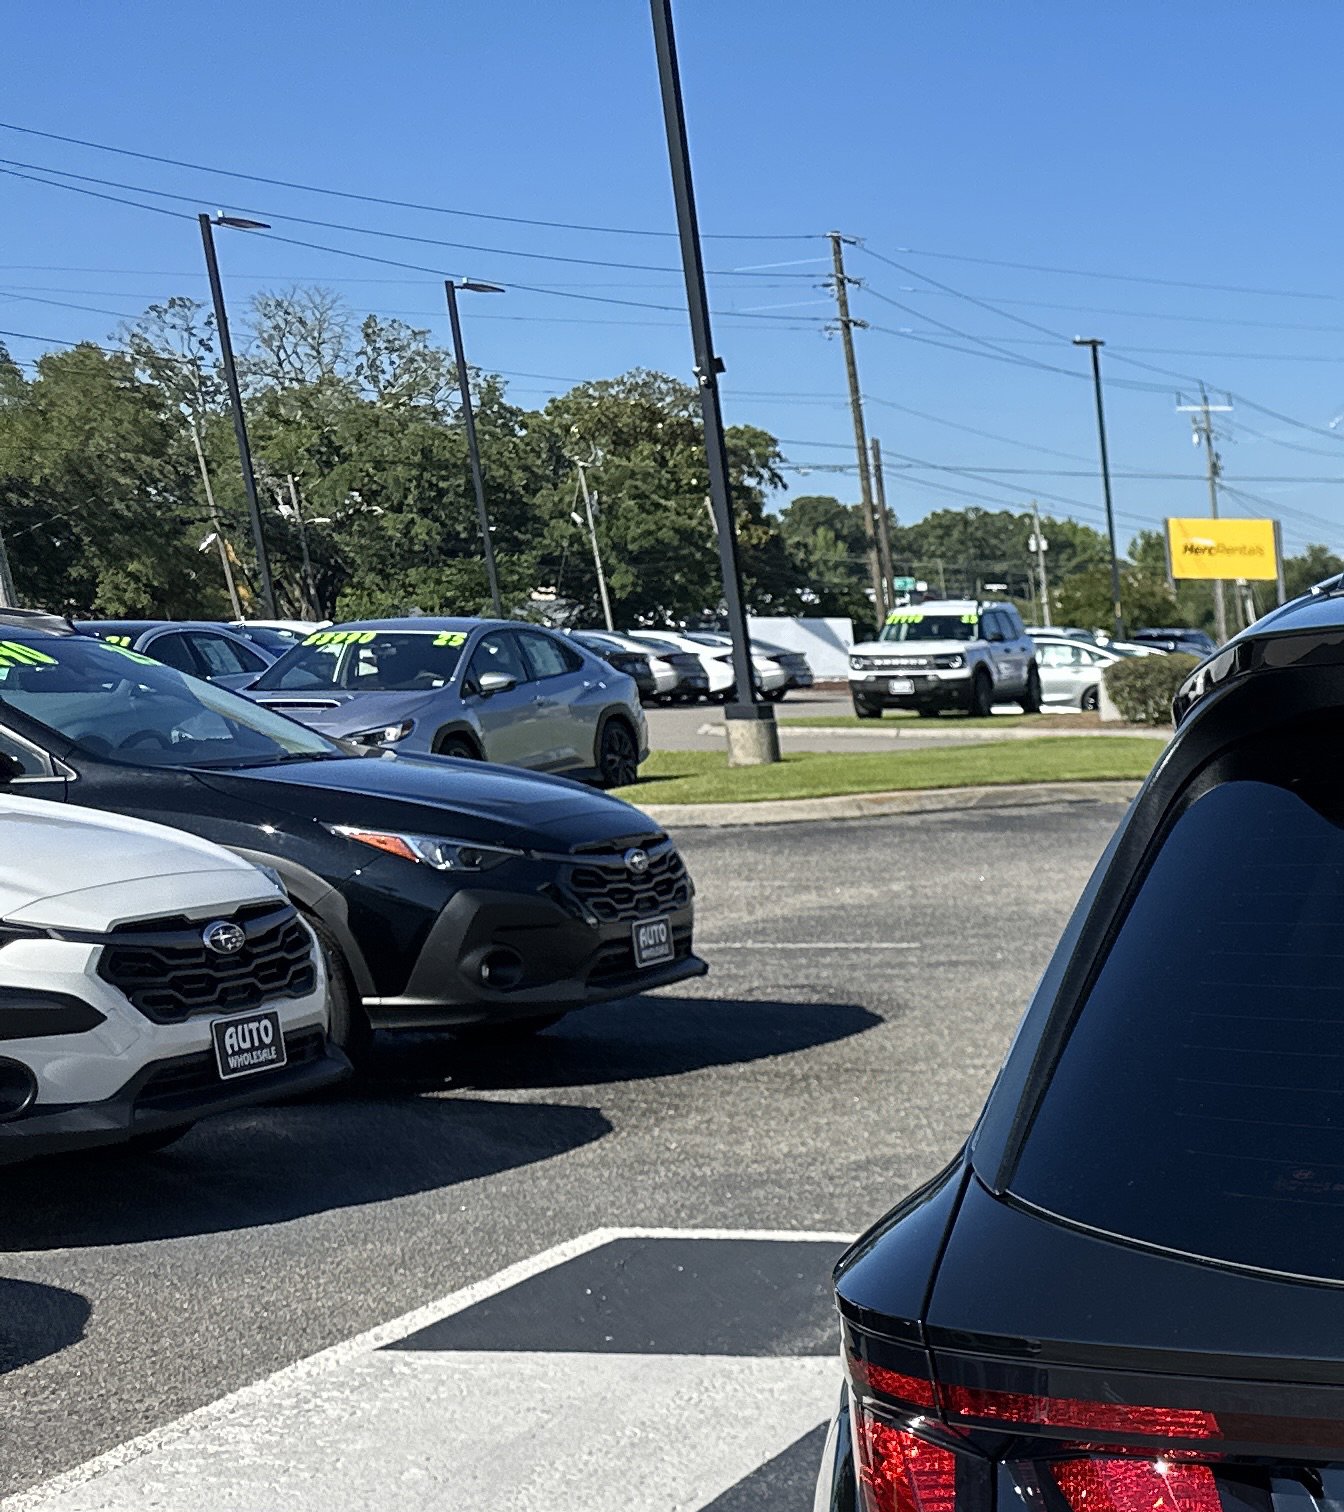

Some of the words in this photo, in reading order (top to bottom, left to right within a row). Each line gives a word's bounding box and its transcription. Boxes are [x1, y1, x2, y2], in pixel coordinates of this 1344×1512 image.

[639, 922, 667, 948] AUTO
[224, 1018, 273, 1056] AUTO
[227, 1046, 278, 1070] WHOLESALE
